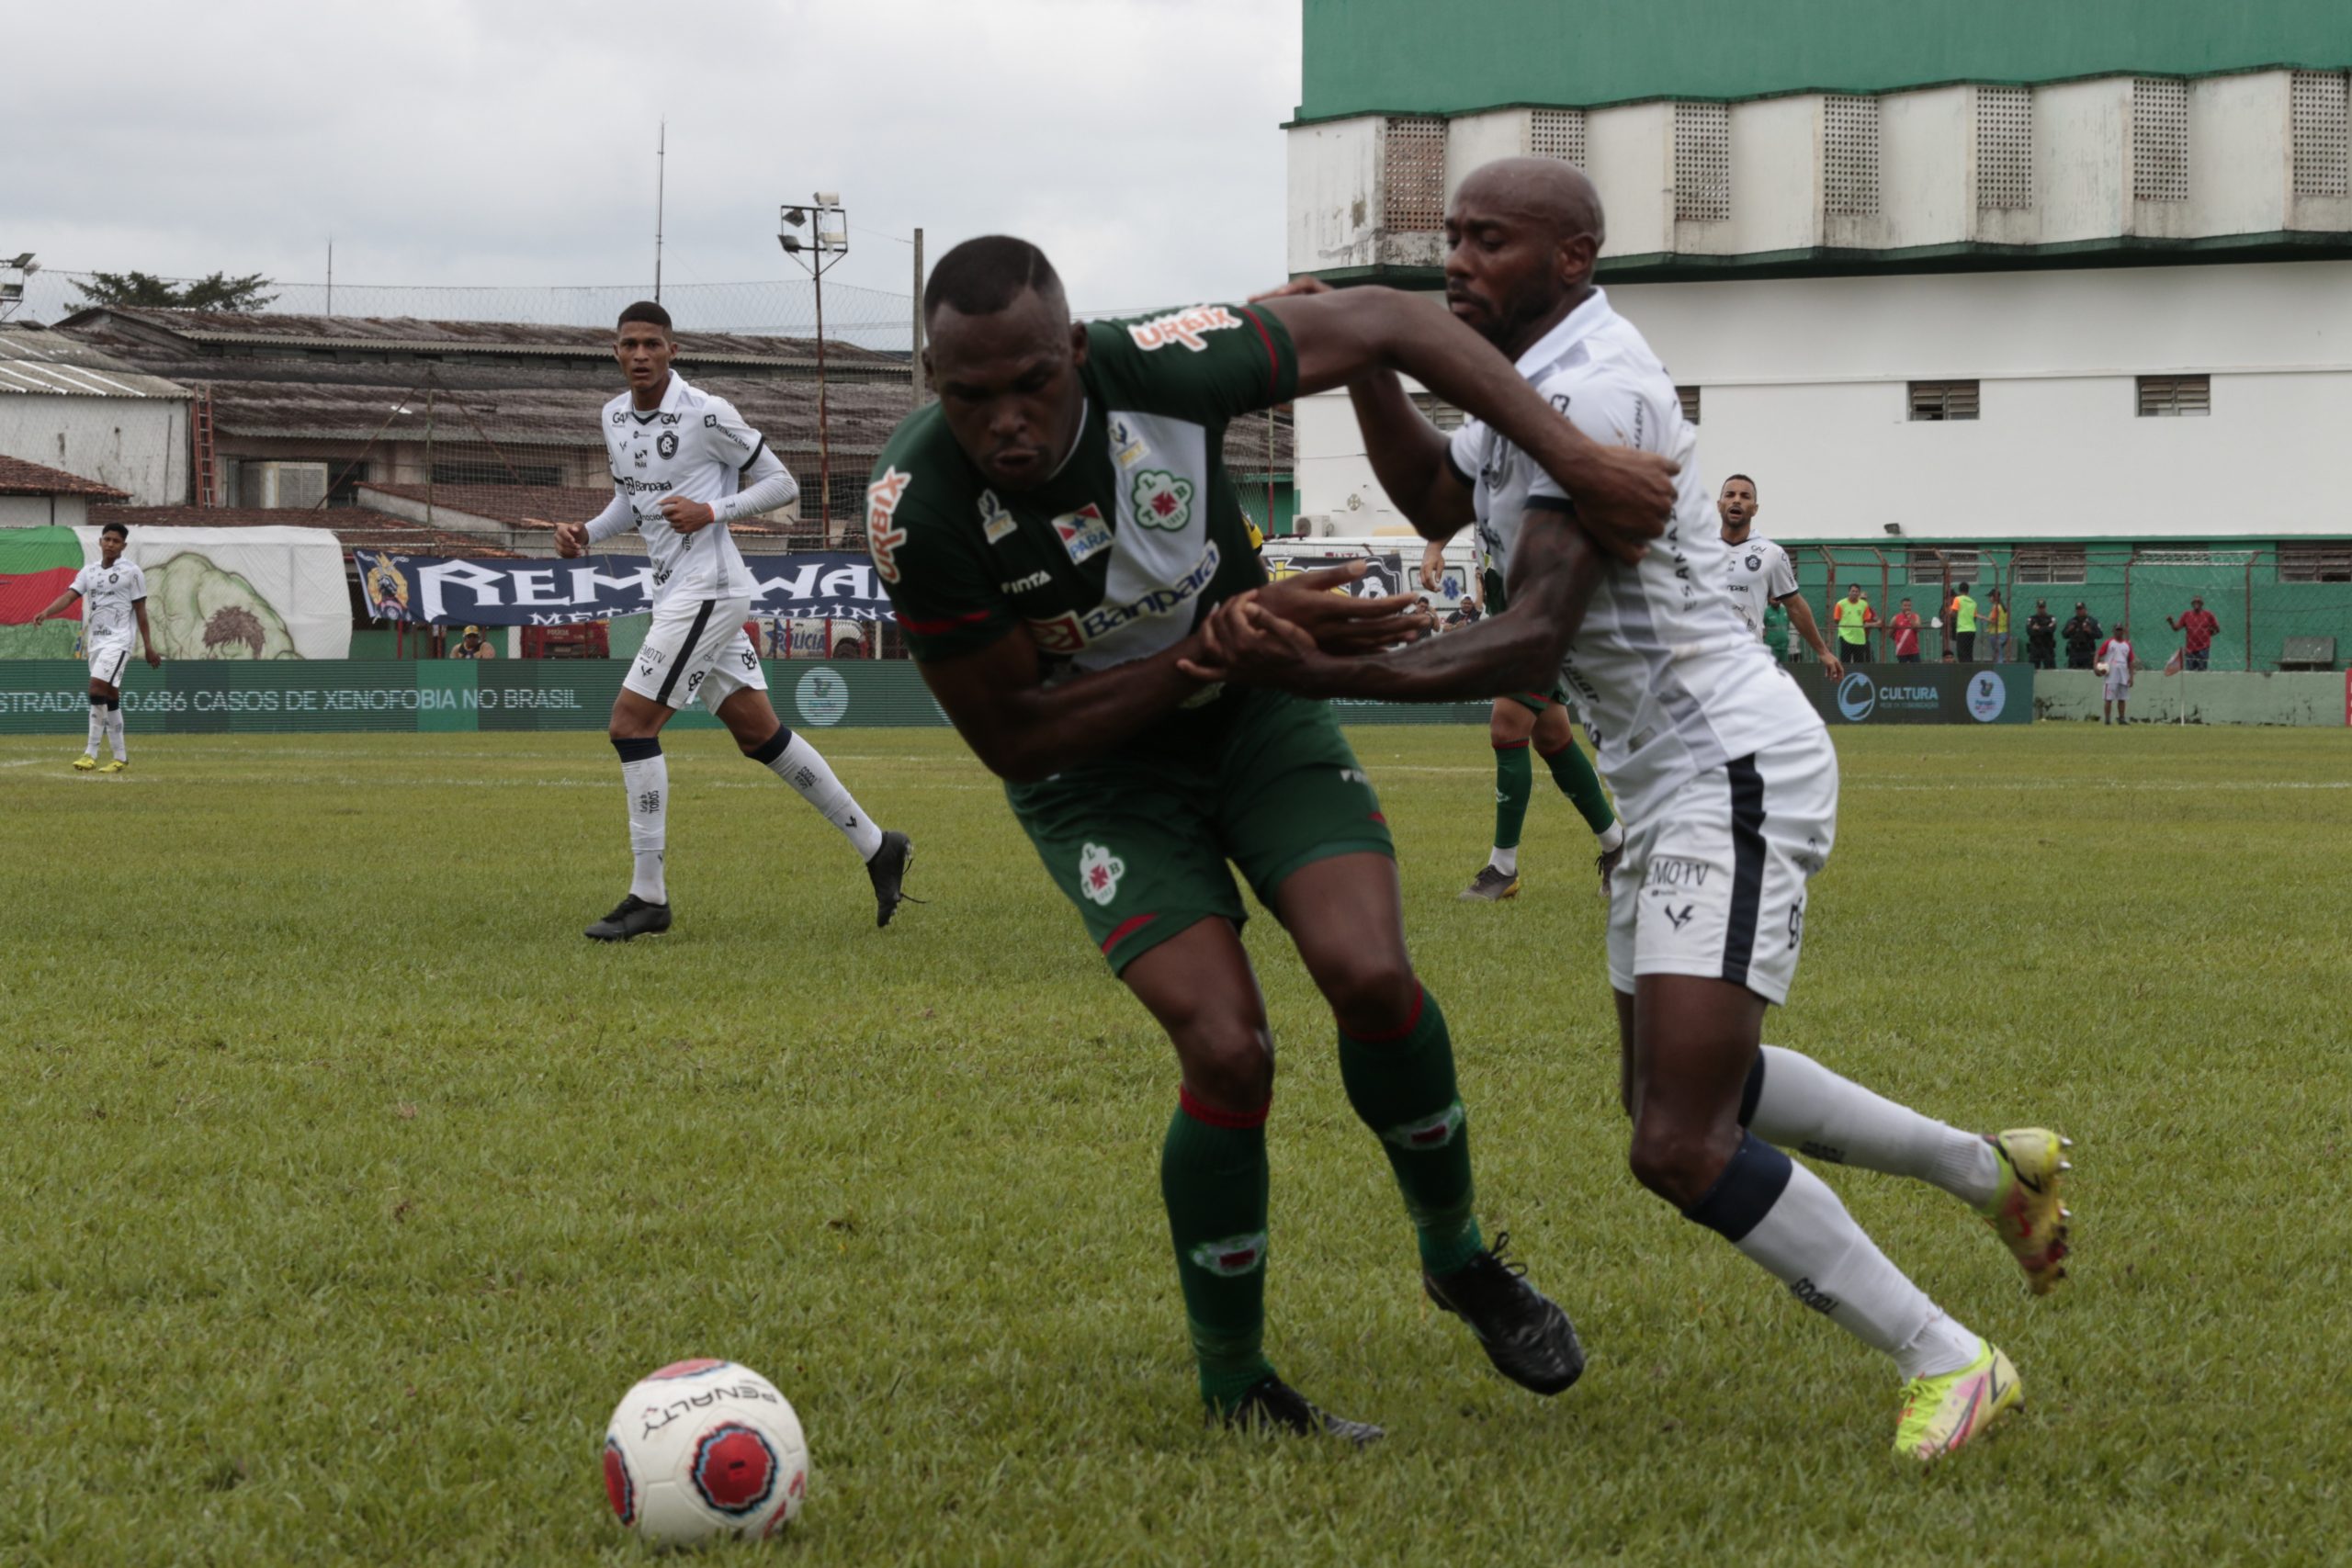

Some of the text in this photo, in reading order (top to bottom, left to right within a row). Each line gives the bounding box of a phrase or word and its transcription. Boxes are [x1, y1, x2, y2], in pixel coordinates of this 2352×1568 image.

[868, 467, 910, 582] URBIX
[416, 558, 653, 623] REM
[193, 691, 279, 711] CASOS
[286, 691, 318, 710] DE
[323, 689, 457, 709] XENOFOBIA
[463, 689, 498, 709] NO
[504, 689, 582, 708] BRASIL
[1880, 686, 1939, 701] CULTURA
[642, 1386, 777, 1439] PENALTY
